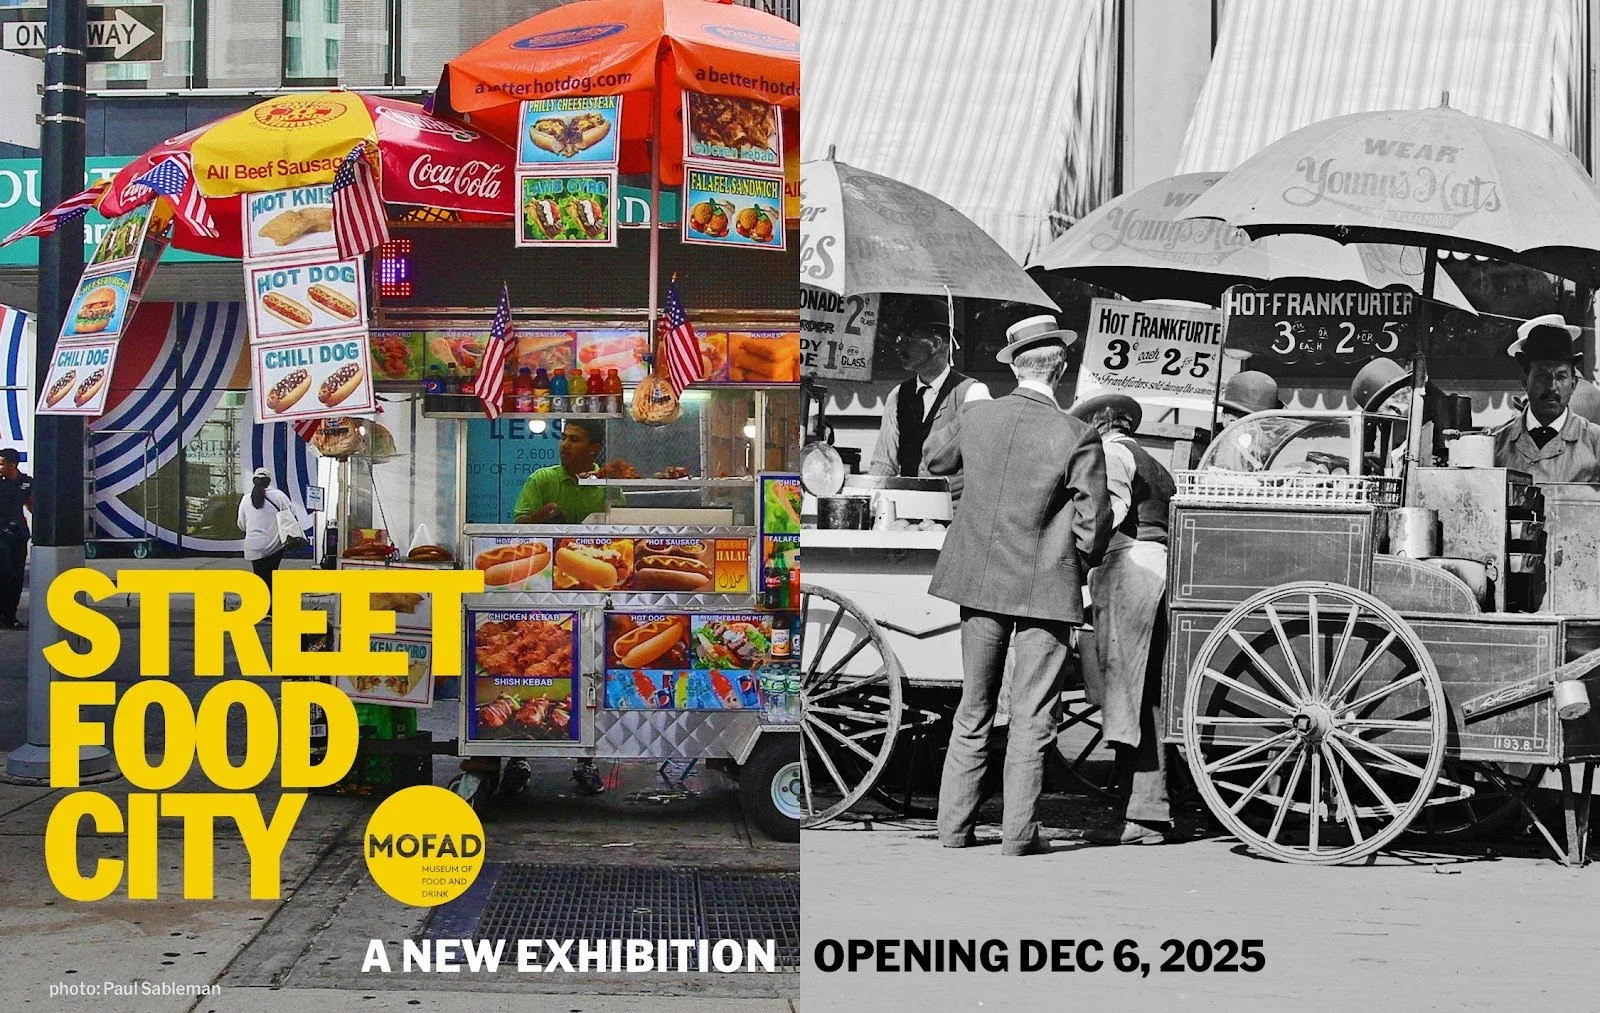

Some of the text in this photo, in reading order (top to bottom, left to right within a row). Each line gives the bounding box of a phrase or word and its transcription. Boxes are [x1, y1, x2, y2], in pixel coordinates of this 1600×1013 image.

[16, 24, 137, 46] ON WAY
[528, 95, 615, 113] PHILLY CHEESE STEAK
[692, 140, 775, 162] chicken kebab
[1365, 137, 1459, 163] WEAR
[206, 155, 343, 180] All Beef Sausag
[409, 153, 506, 199] Coca-Cola
[566, 178, 608, 196] GYRO
[691, 172, 730, 194] FALAFEL
[731, 178, 778, 199] SANDWICH
[1413, 166, 1501, 213] Hats
[251, 187, 334, 221] HOT KNIS
[257, 269, 301, 300] HOT
[308, 265, 356, 284] DOG
[1099, 308, 1221, 345] HOT FRANKFURTE
[1336, 321, 1356, 354] 2
[1375, 321, 1399, 353] 5
[57, 348, 109, 367] CHILI DOG
[265, 342, 359, 370] CHILI DOG
[1138, 347, 1160, 361] each
[1161, 348, 1181, 376] 2
[1148, 380, 1163, 391] sold
[1162, 381, 1185, 395] during
[1184, 383, 1195, 394] the
[1195, 387, 1216, 396] summe
[490, 418, 562, 440] LES
[489, 463, 508, 475] OF
[649, 538, 665, 546] HOT
[716, 550, 748, 562] HALAL
[488, 613, 560, 621] CHICKEN KEBAB
[370, 641, 393, 652] KEN
[494, 677, 554, 686] SHISH KEBAB
